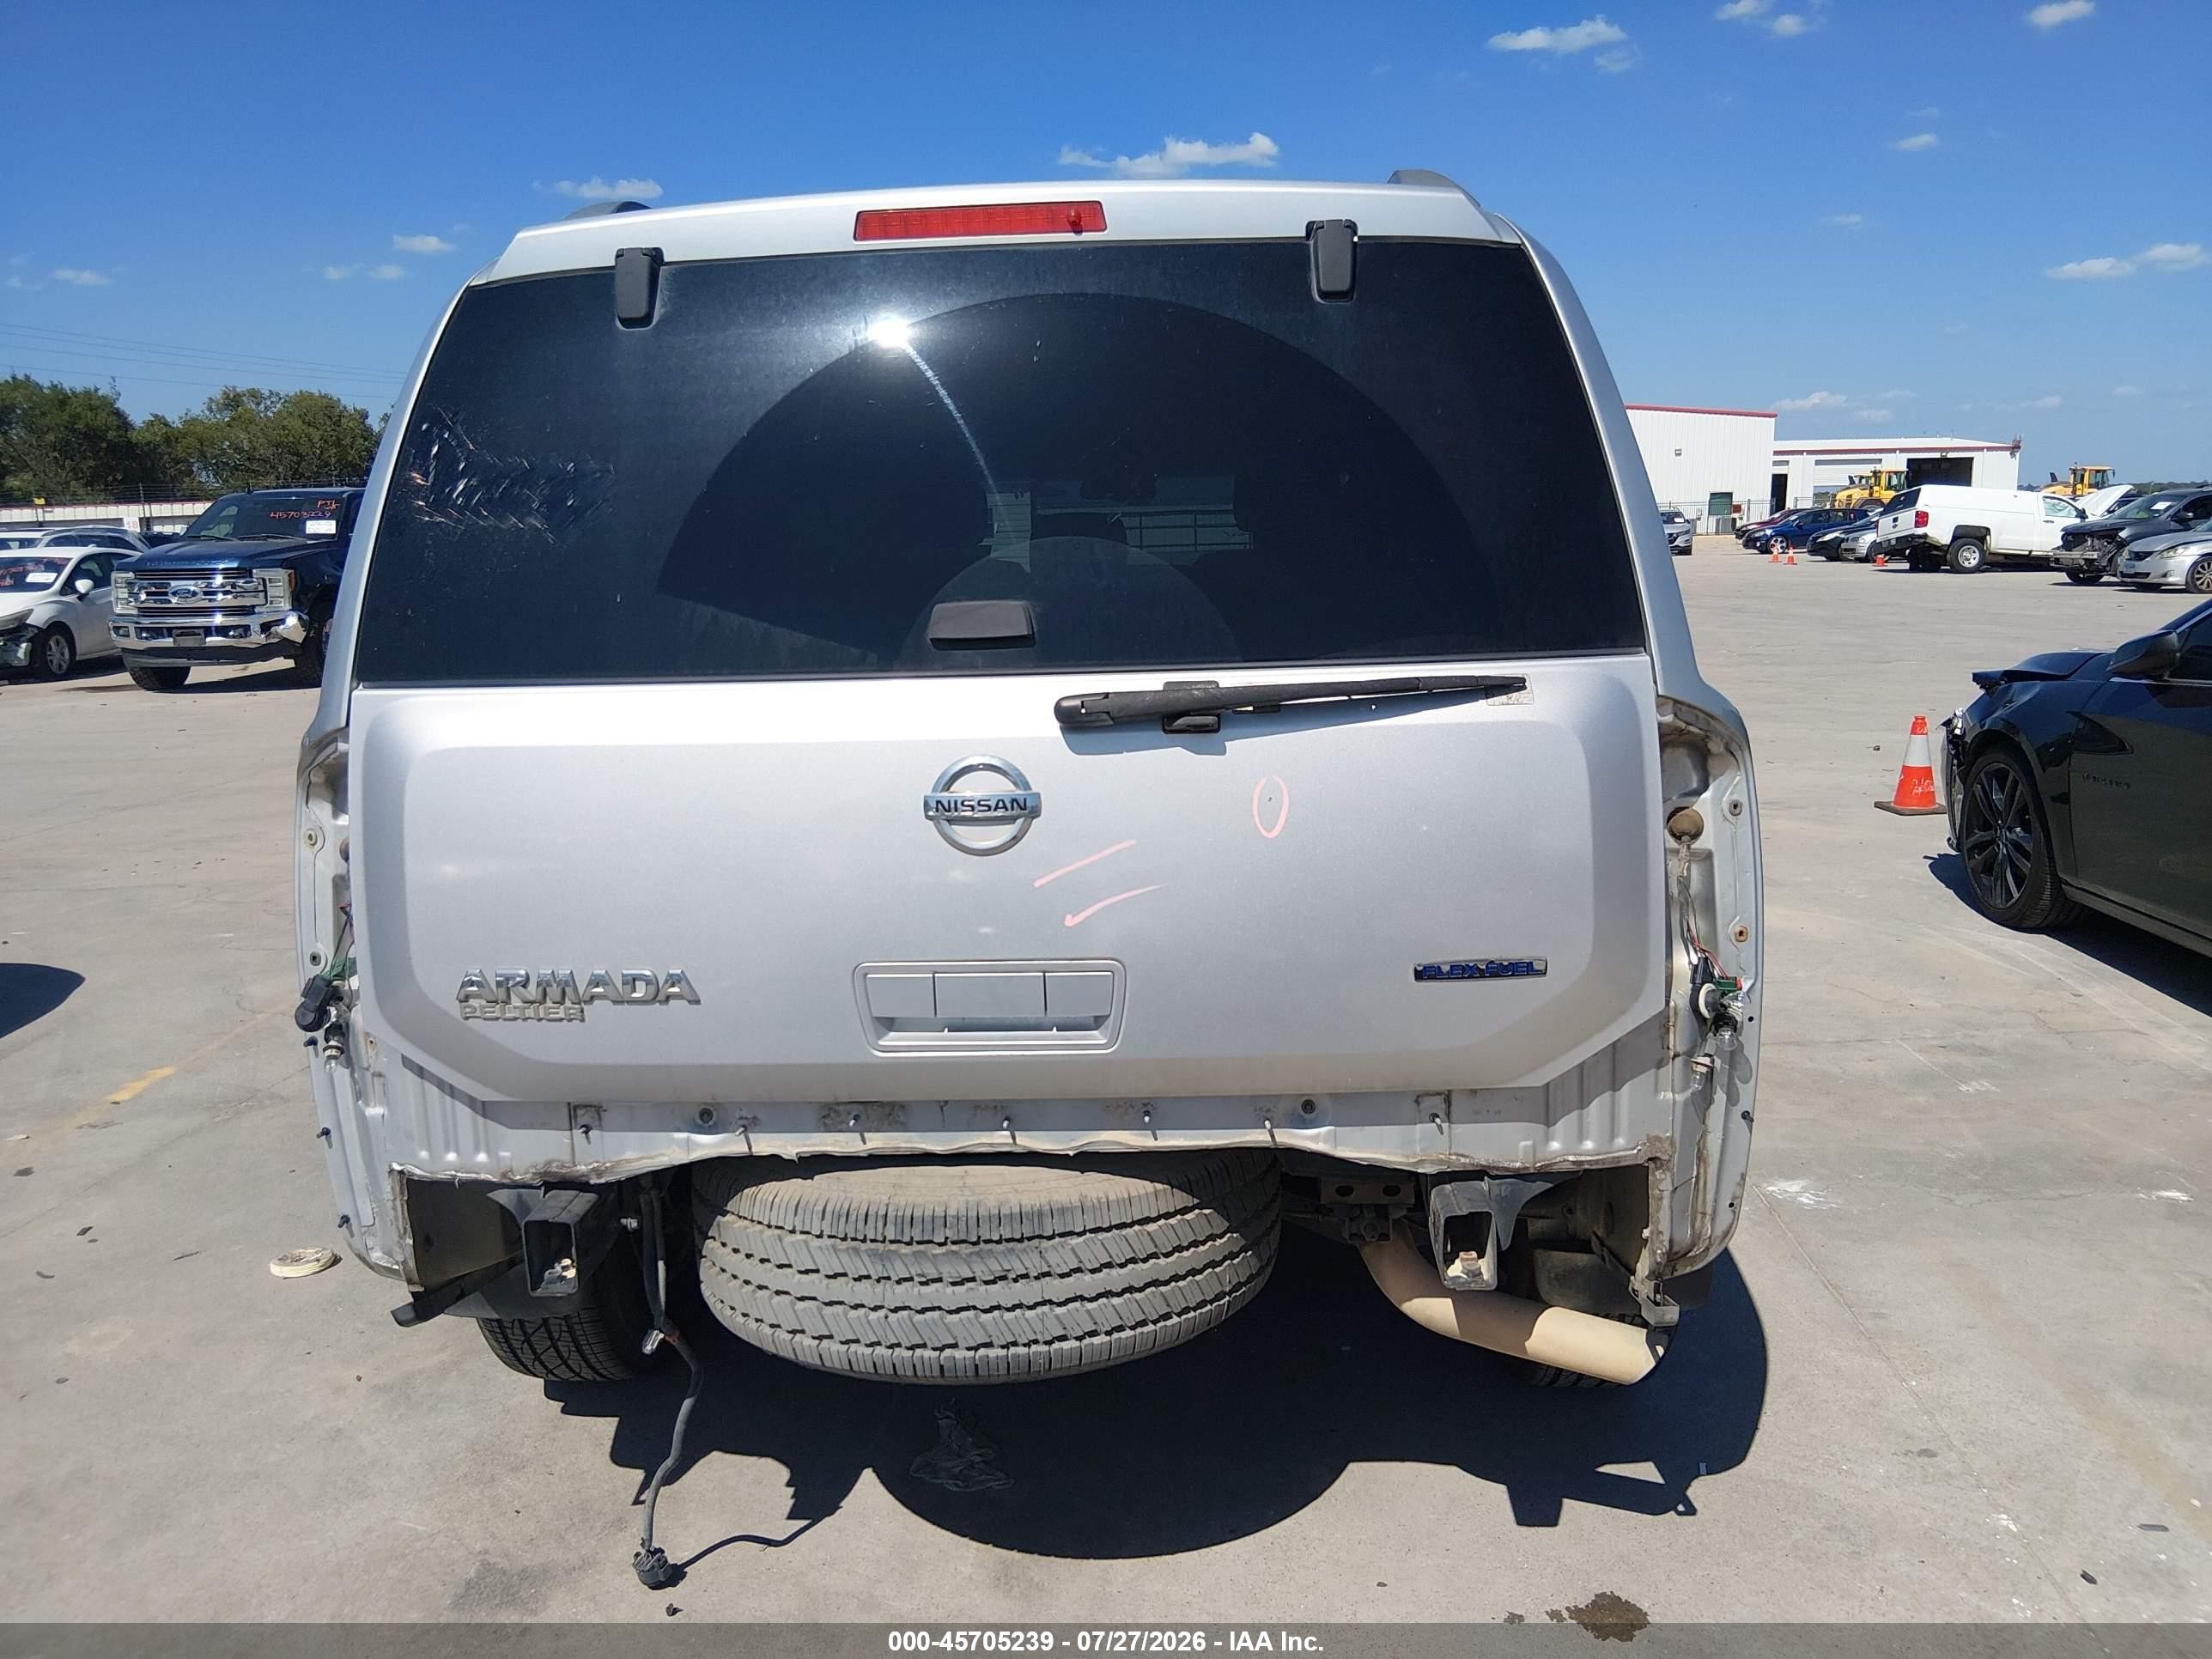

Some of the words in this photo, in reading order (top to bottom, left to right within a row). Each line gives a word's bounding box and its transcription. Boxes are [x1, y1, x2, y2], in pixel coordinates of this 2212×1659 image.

[934, 797, 1028, 813] NISSAN
[1422, 963, 1479, 979] FLEX
[1485, 960, 1544, 976] FUEL
[456, 968, 702, 1006] ARMADA
[460, 1003, 585, 1022] PELTIER
